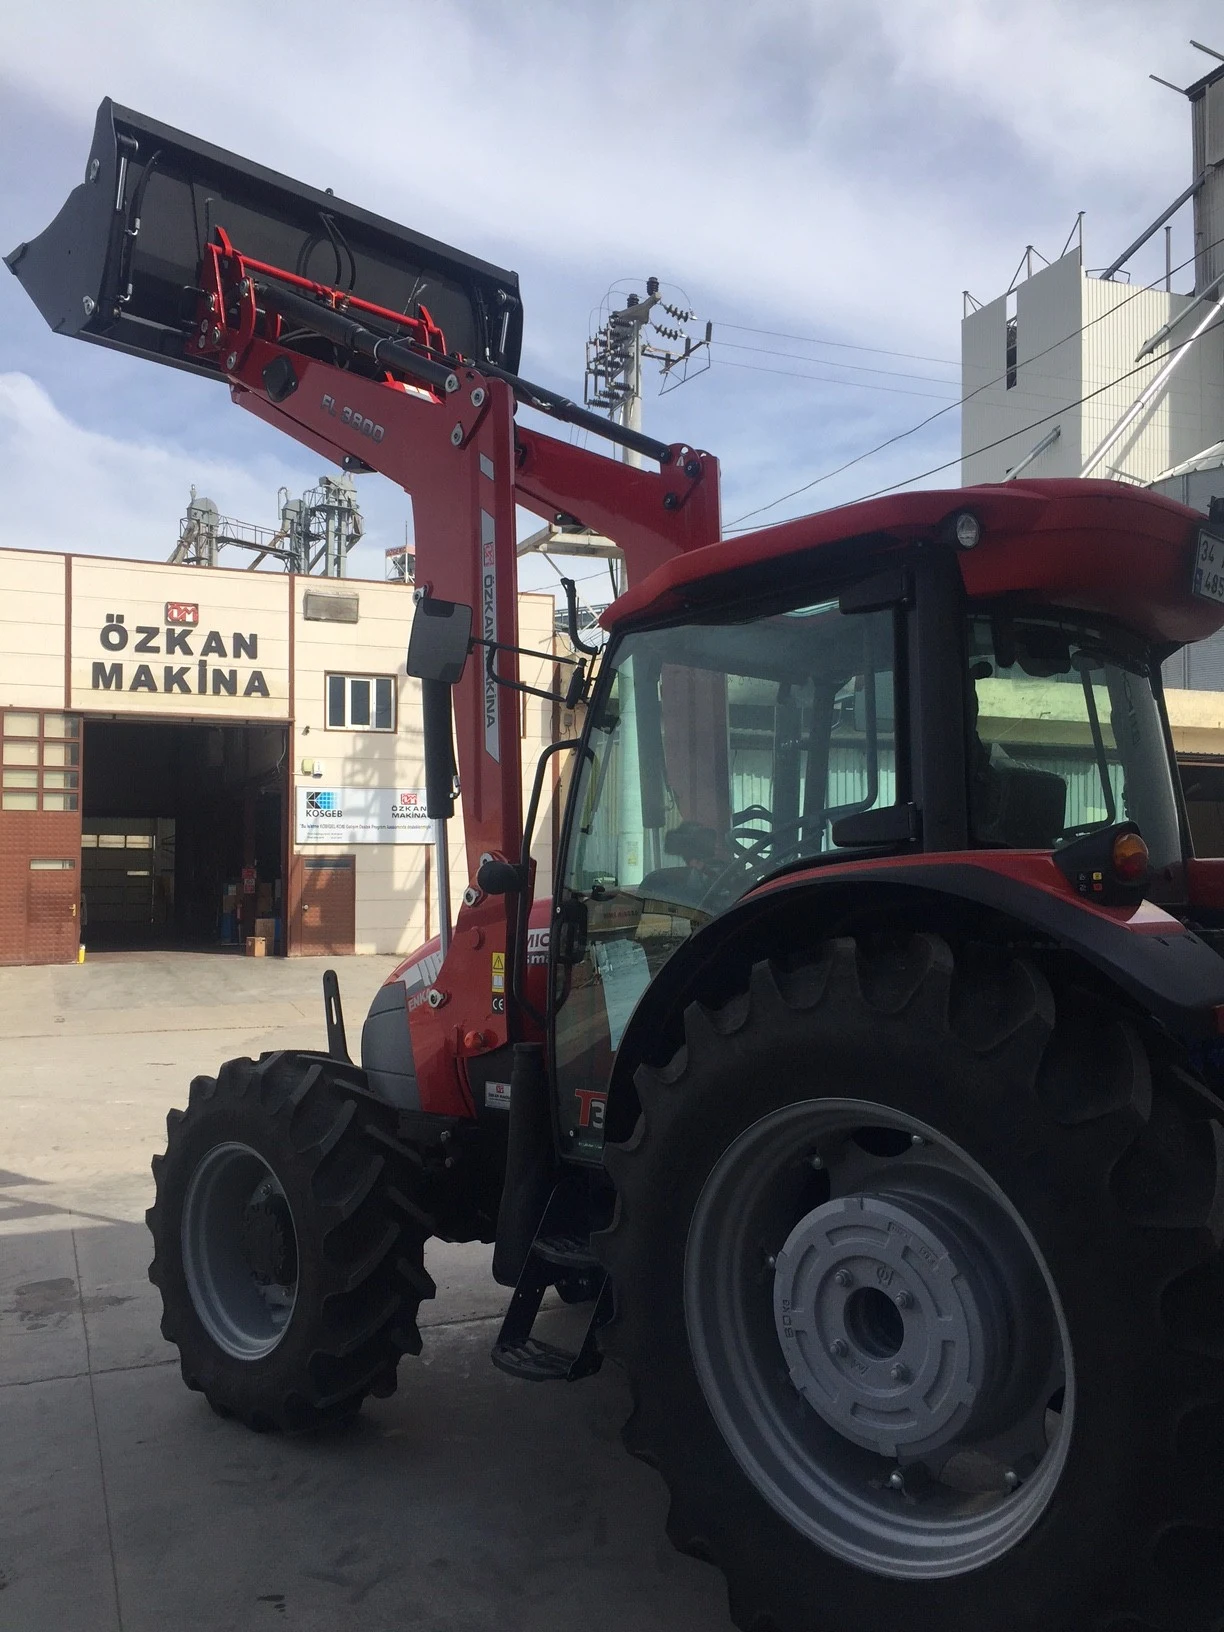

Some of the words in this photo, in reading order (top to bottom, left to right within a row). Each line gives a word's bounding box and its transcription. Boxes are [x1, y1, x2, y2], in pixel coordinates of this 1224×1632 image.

[100, 613, 258, 660] ÖZKAN
[92, 659, 270, 697] MAKİNA
[306, 809, 343, 818] KOSGEB
[492, 998, 504, 1011] CE
